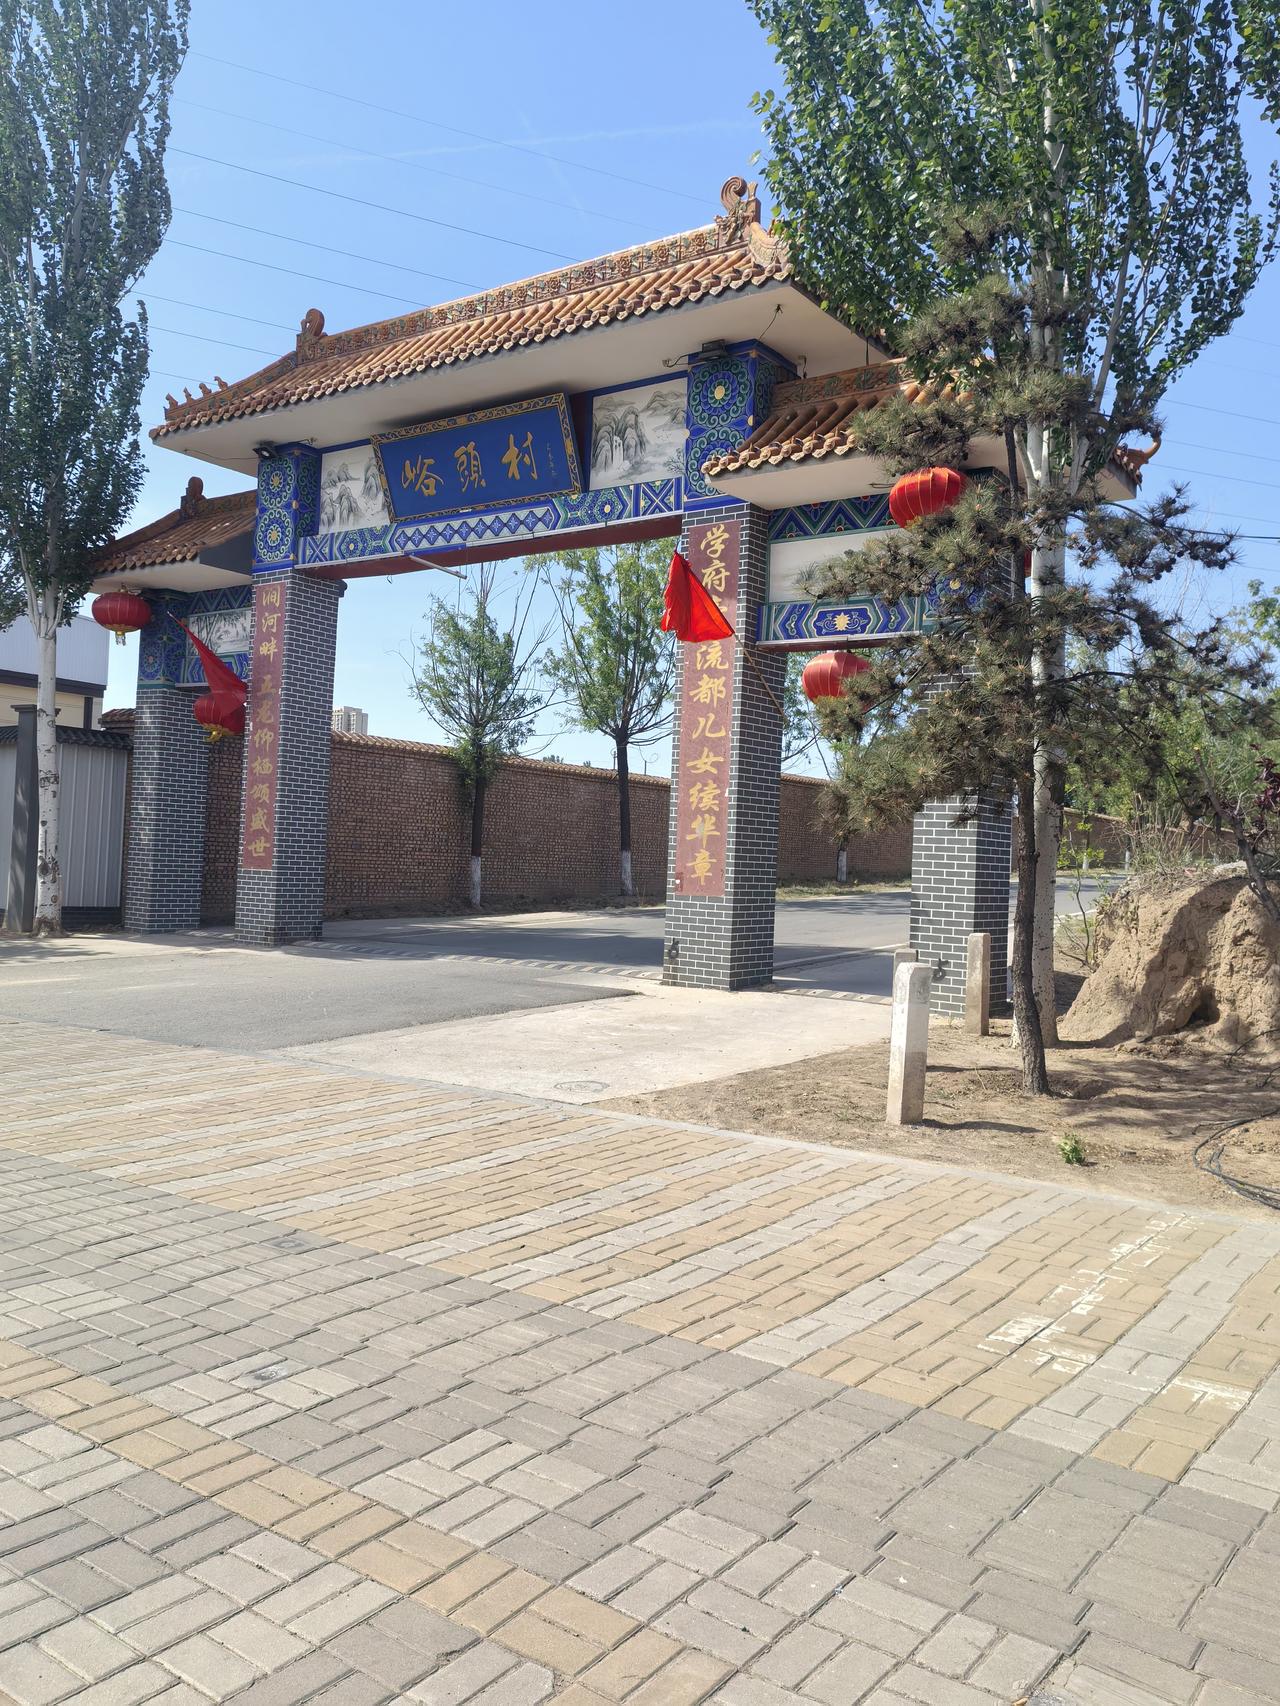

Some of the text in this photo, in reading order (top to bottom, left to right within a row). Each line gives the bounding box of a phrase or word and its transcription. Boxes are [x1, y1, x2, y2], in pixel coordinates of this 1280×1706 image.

[686, 523, 730, 886] 学府流都儿女续华章
